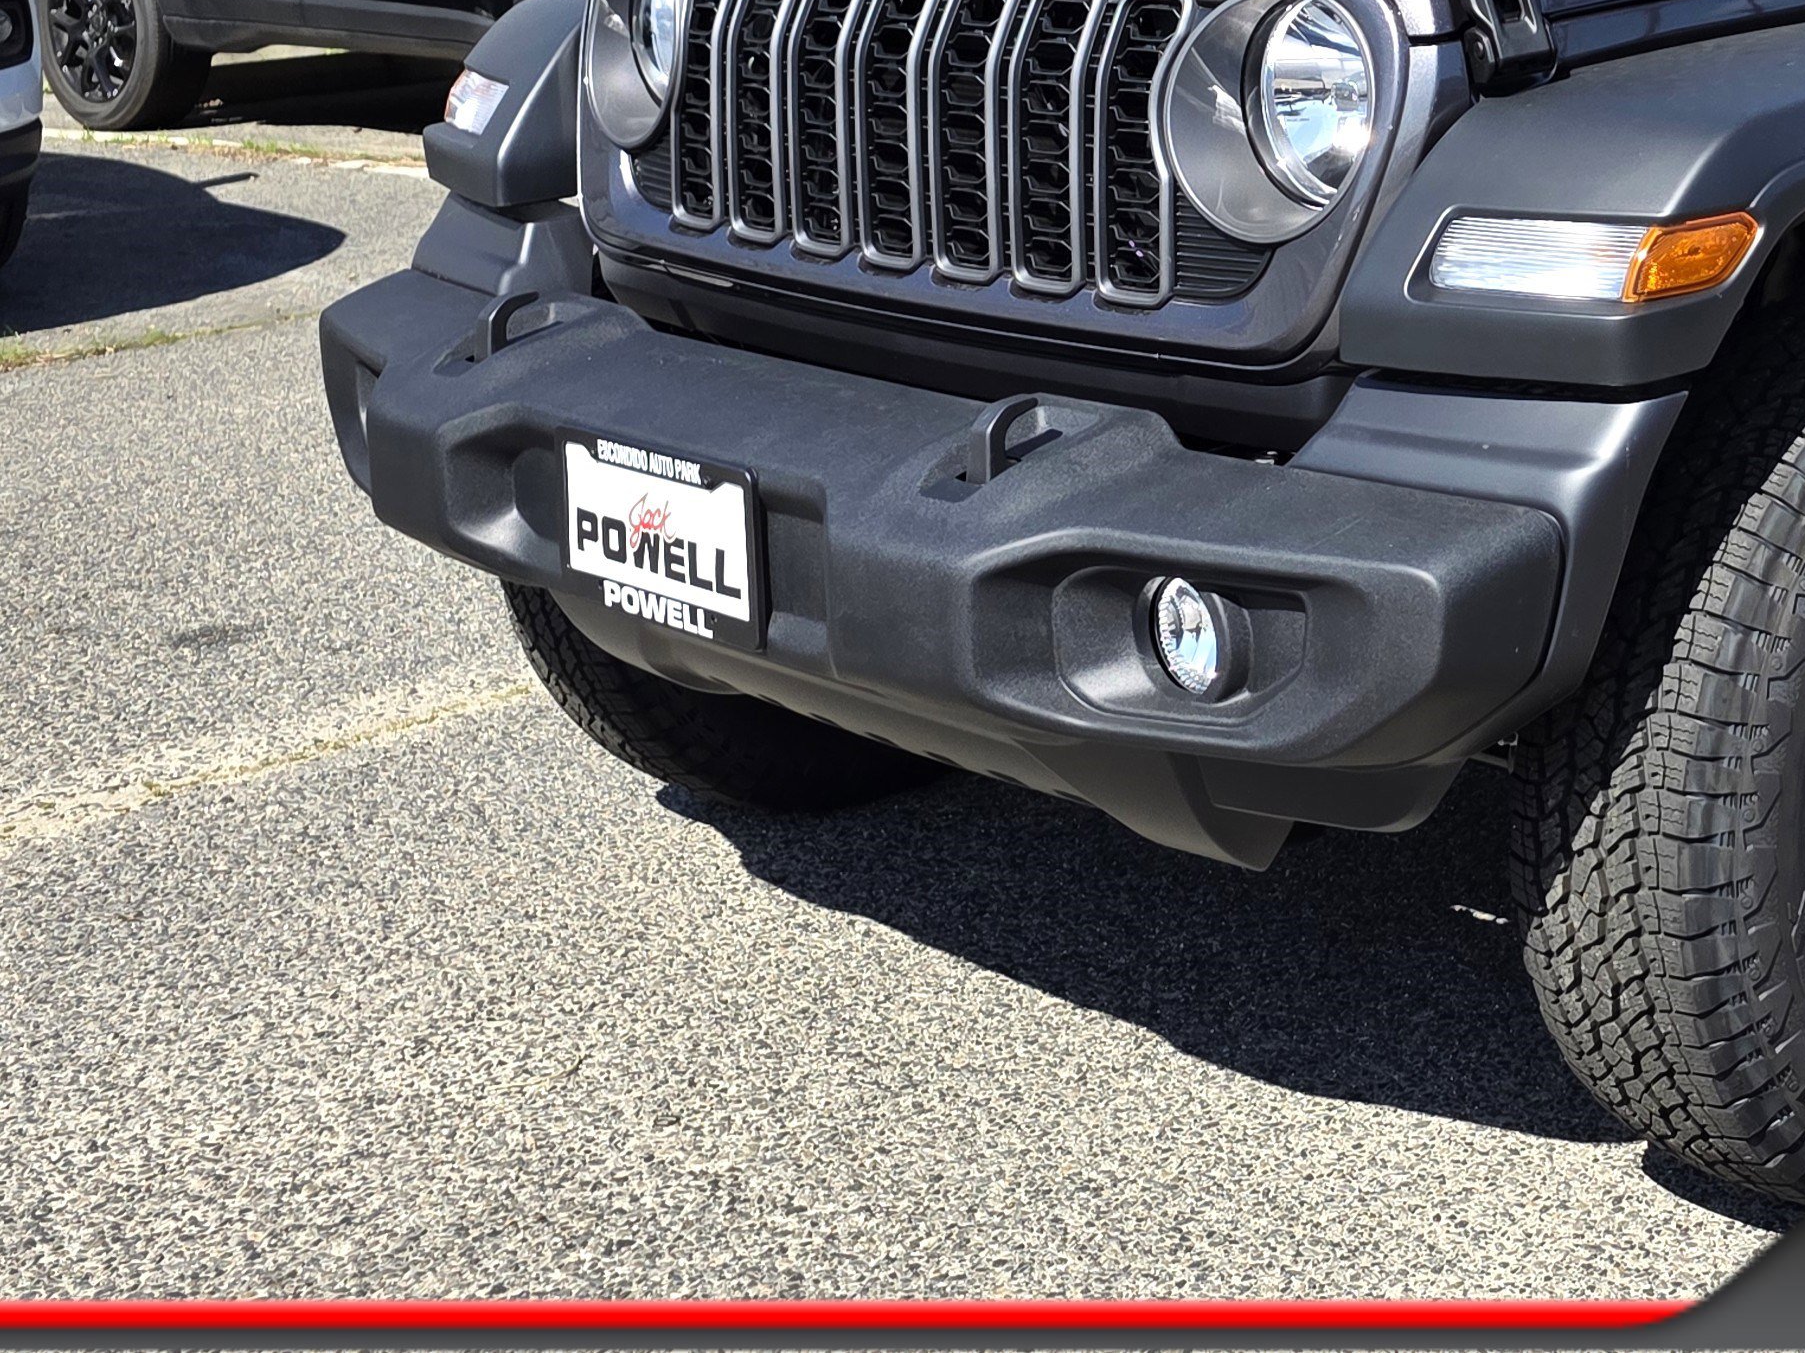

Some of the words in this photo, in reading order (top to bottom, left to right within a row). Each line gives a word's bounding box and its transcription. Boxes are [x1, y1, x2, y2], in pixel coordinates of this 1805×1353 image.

[597, 439, 648, 472] ESCONDIDO
[649, 452, 674, 478] AUTO
[674, 458, 702, 485] PARK
[629, 492, 677, 549] Jack
[576, 506, 742, 600] POWELL
[602, 579, 714, 639] POWELL
